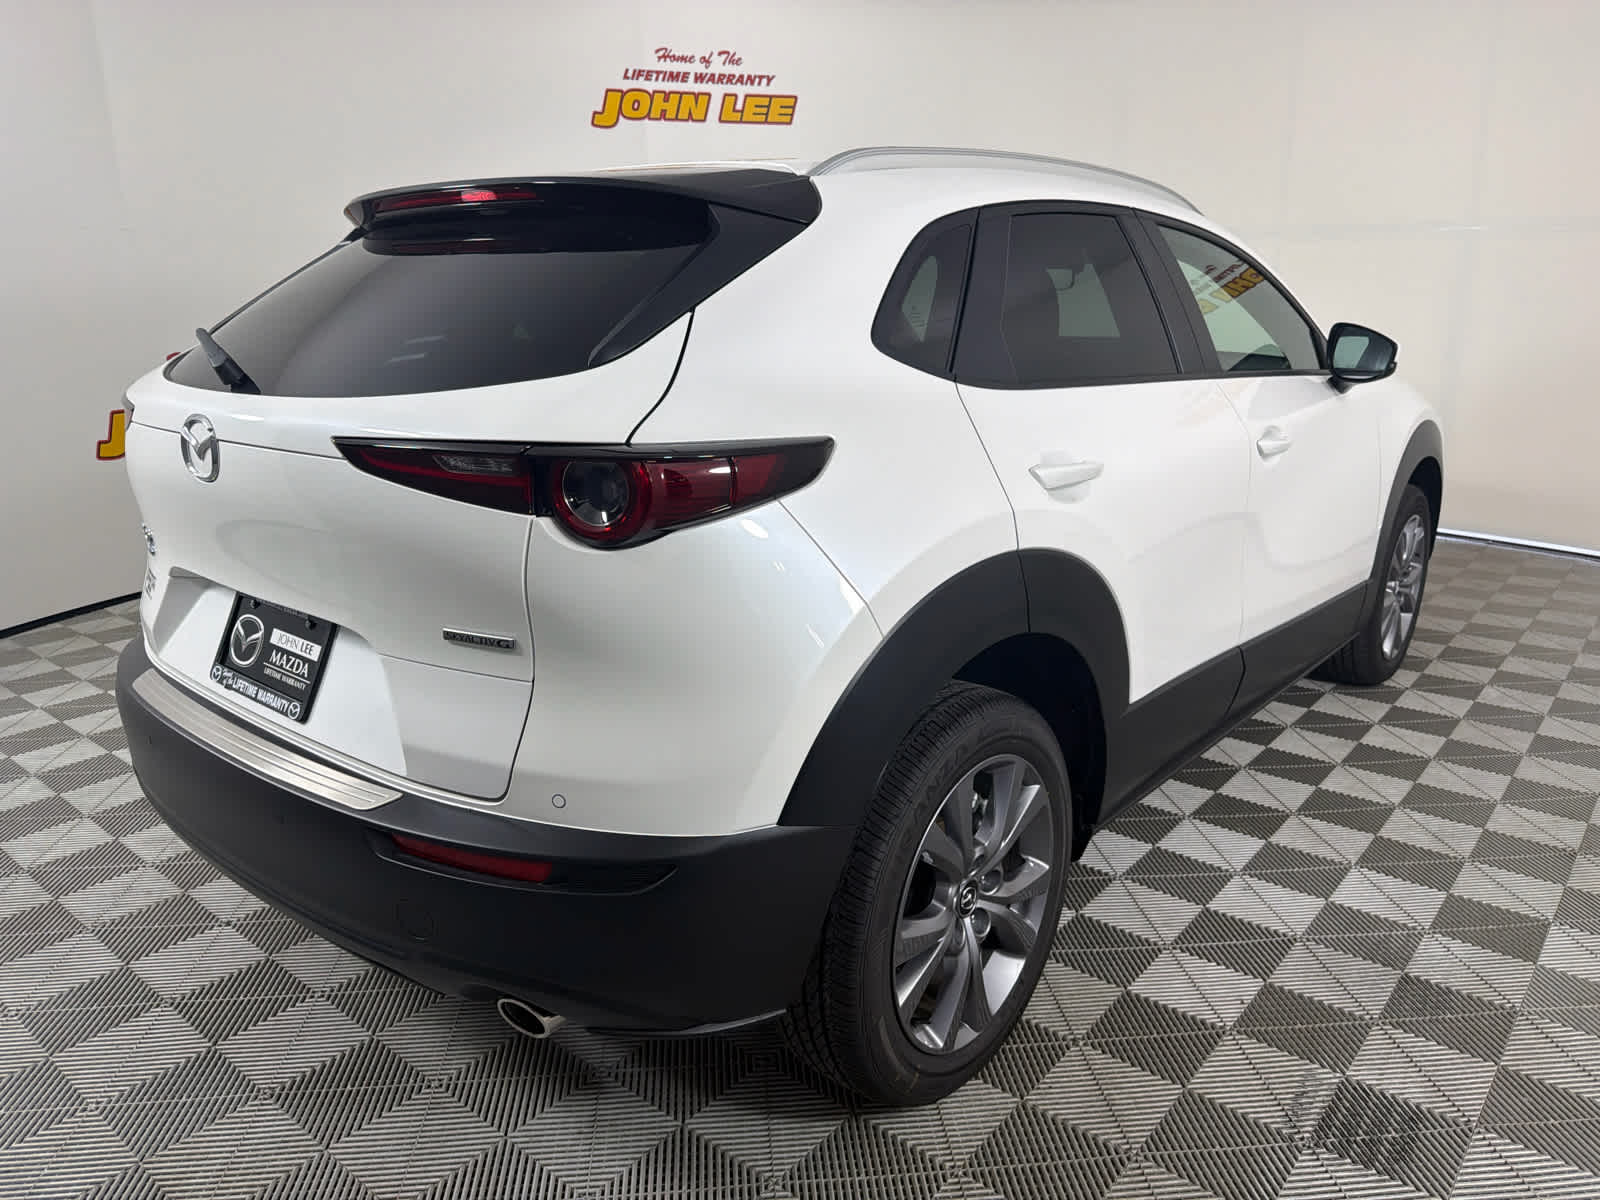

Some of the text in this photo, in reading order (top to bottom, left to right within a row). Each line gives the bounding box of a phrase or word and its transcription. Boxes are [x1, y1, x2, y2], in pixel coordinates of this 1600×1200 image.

[655, 47, 743, 69] Home of The
[622, 68, 776, 86] LIFETIME WARRANTY
[591, 88, 798, 129] JOHN LEE
[278, 633, 315, 656] JOHN LEE
[269, 649, 309, 678] MAZDA
[232, 676, 258, 698] LIFETIME
[256, 688, 290, 713] WARRANTY
